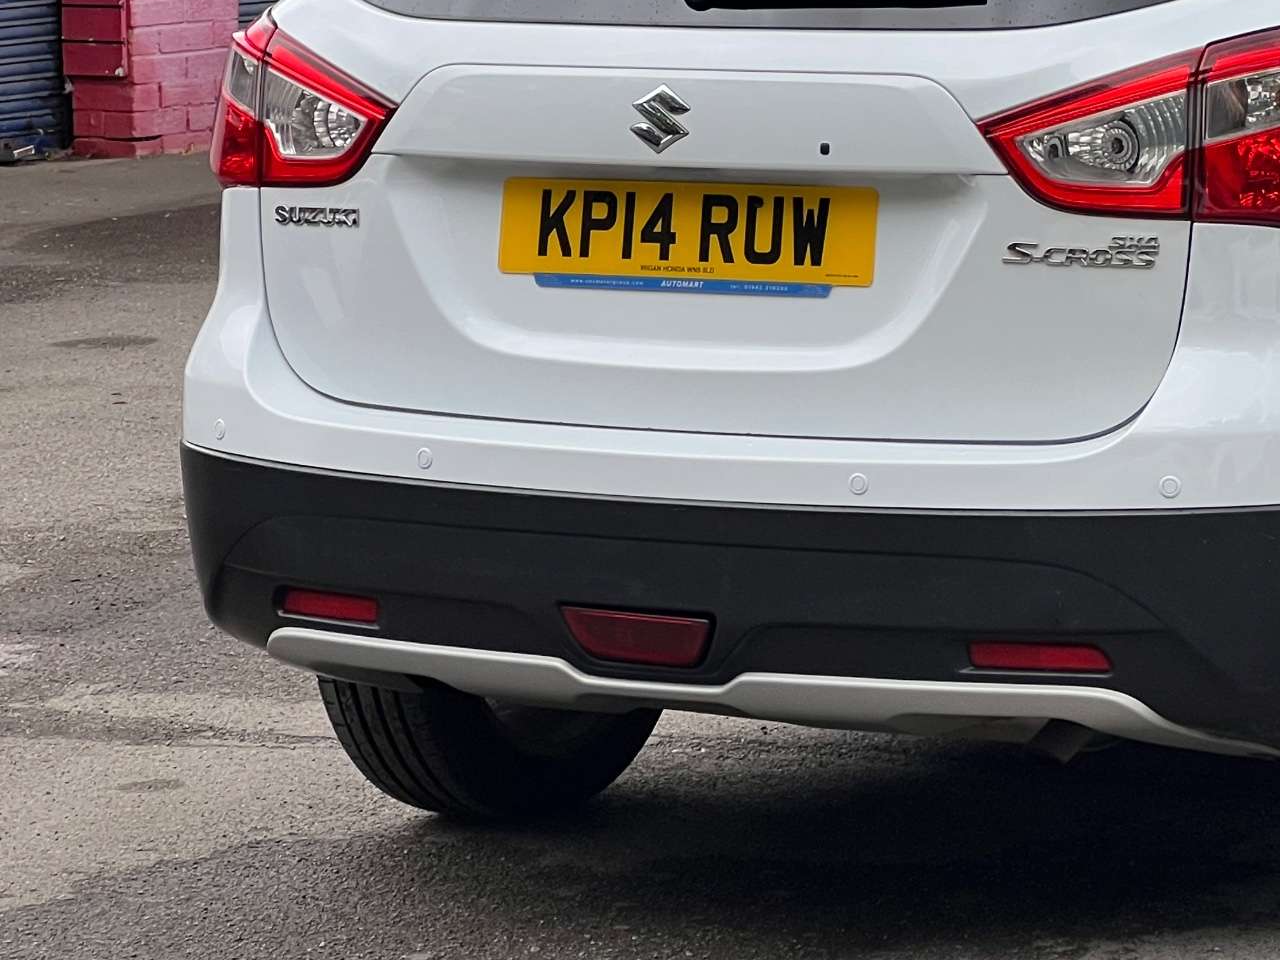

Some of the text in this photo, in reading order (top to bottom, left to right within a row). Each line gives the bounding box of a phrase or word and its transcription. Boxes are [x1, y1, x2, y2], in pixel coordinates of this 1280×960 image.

[275, 205, 360, 228] SUZUKI
[537, 188, 832, 267] KP14 RUW
[660, 280, 705, 289] AUTOMART
